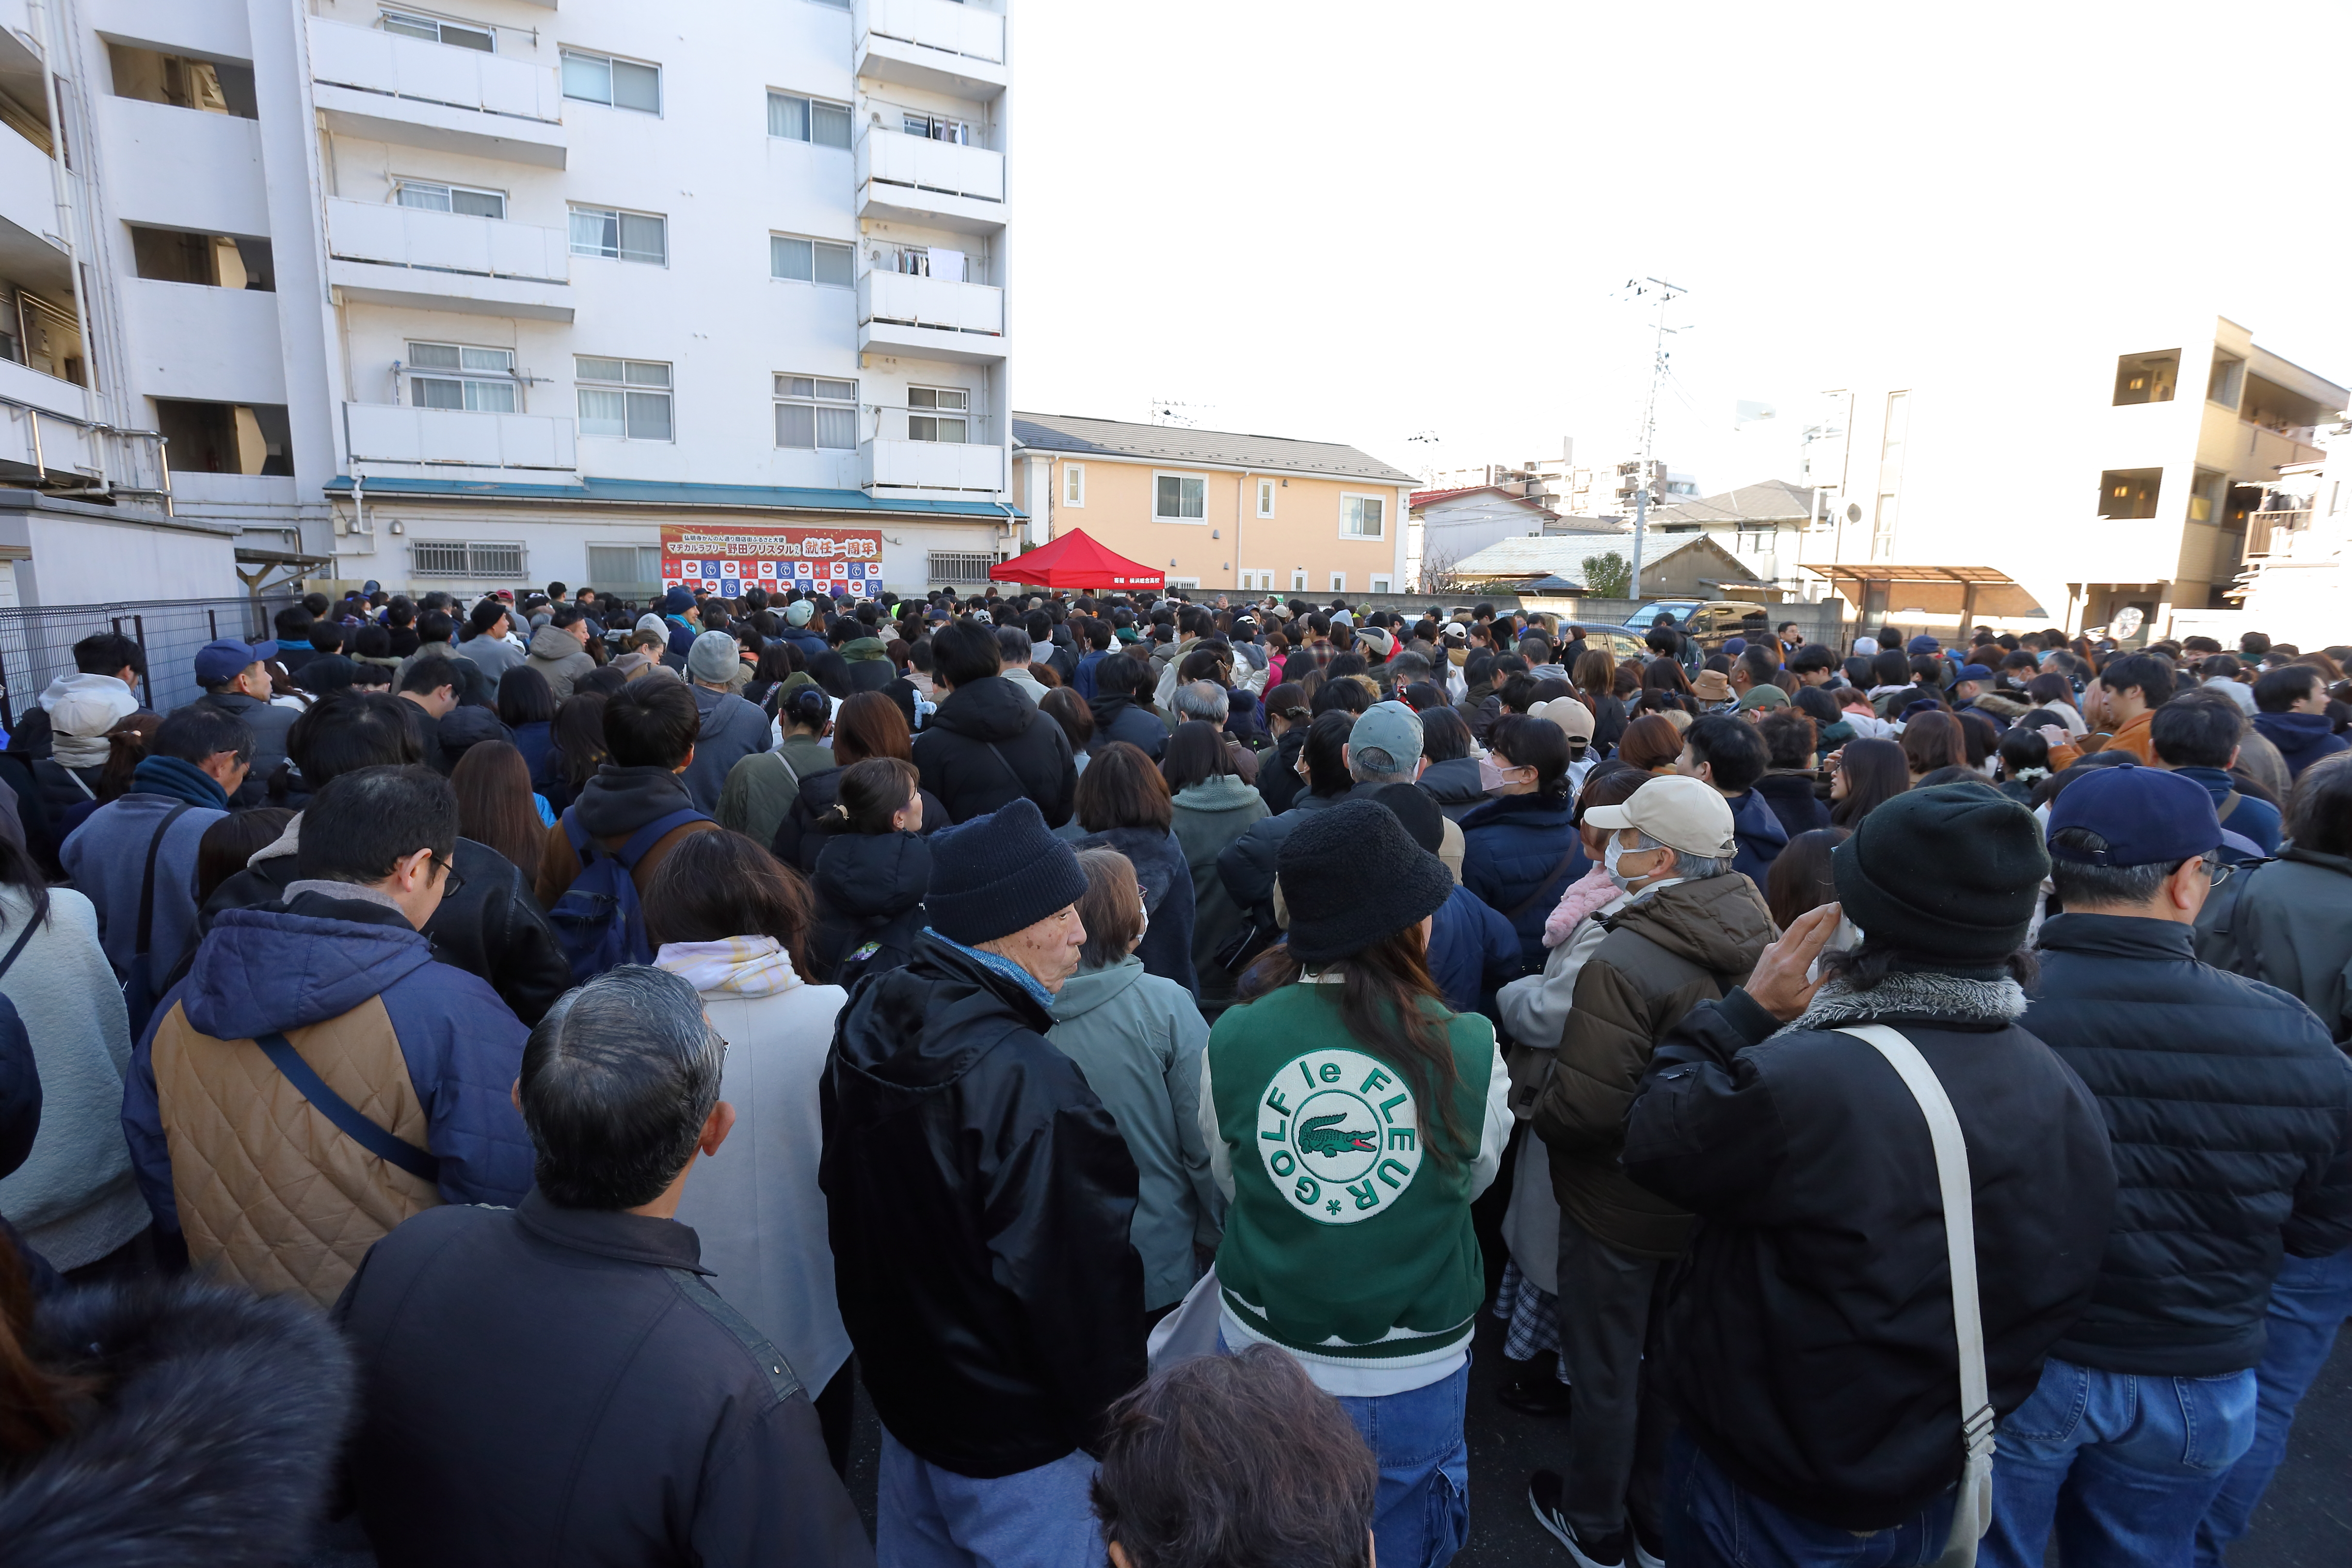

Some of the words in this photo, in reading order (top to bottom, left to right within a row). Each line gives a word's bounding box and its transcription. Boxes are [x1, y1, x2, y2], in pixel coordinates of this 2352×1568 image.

[684, 535, 784, 543] 弘明寺かんのん通り商店街ふるさと大使
[805, 541, 874, 555] 就任一周年
[1261, 1087, 1321, 1205] GOLF
[1299, 1061, 1341, 1089] le
[1345, 1068, 1415, 1210] FLEUR
